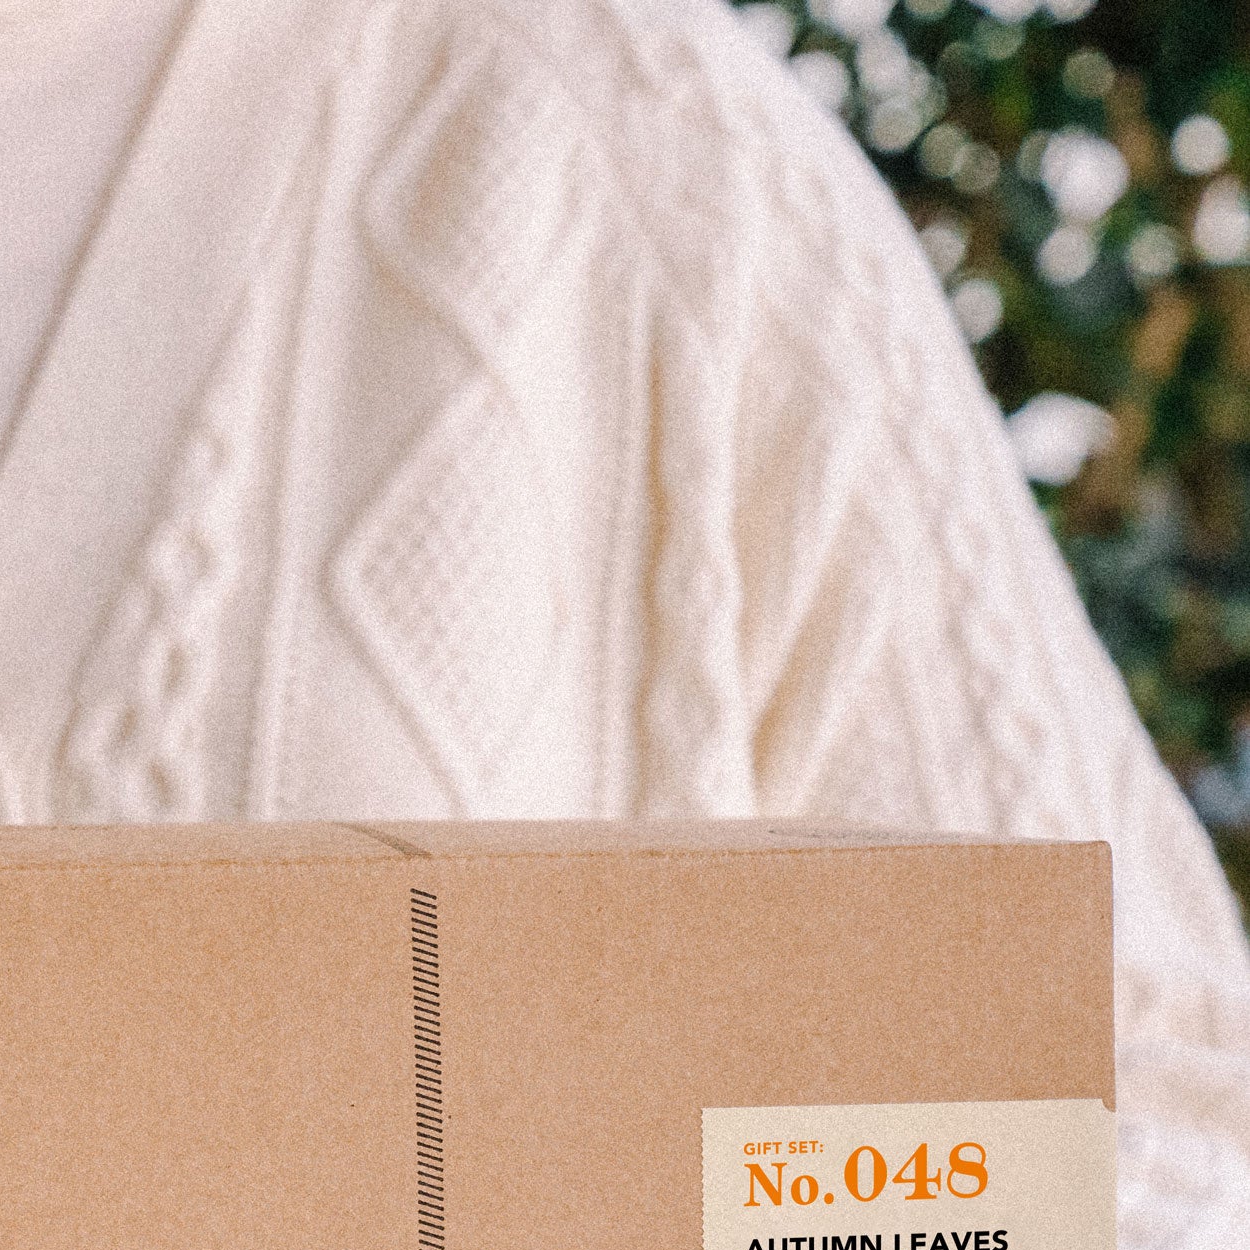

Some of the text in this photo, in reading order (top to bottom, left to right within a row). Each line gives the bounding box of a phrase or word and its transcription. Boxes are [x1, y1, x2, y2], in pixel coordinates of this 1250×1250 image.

[743, 1140, 824, 1155] GIFT SET:
[743, 1141, 989, 1207] No. 048
